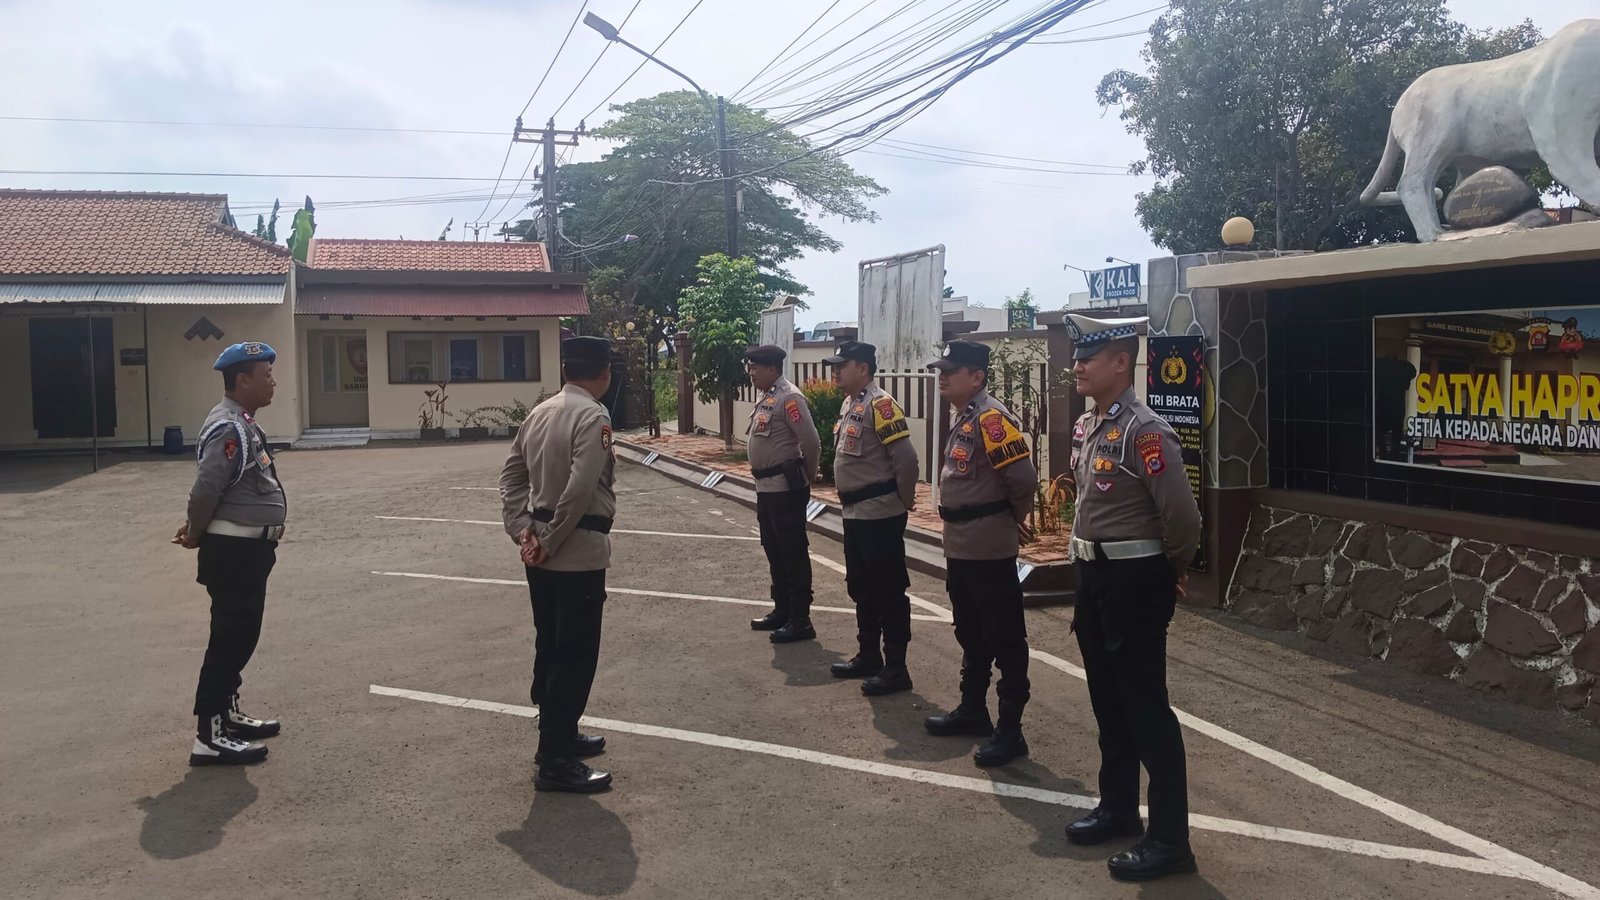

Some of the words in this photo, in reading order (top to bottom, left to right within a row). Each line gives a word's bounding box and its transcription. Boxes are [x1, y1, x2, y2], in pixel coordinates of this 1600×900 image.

[1106, 268, 1135, 289] KAL
[1149, 394, 1164, 406] TRI
[1166, 395, 1200, 408] BRATA
[1416, 372, 1504, 417] SATYA
[1511, 374, 1600, 421] HAPR
[1174, 415, 1200, 424] INDONESIA
[1407, 417, 1442, 438] SETIA
[1445, 419, 1500, 442] KEPADA
[1502, 422, 1563, 446] NEGARA
[1566, 425, 1600, 449] DAN
[1096, 444, 1122, 455] POLRI
